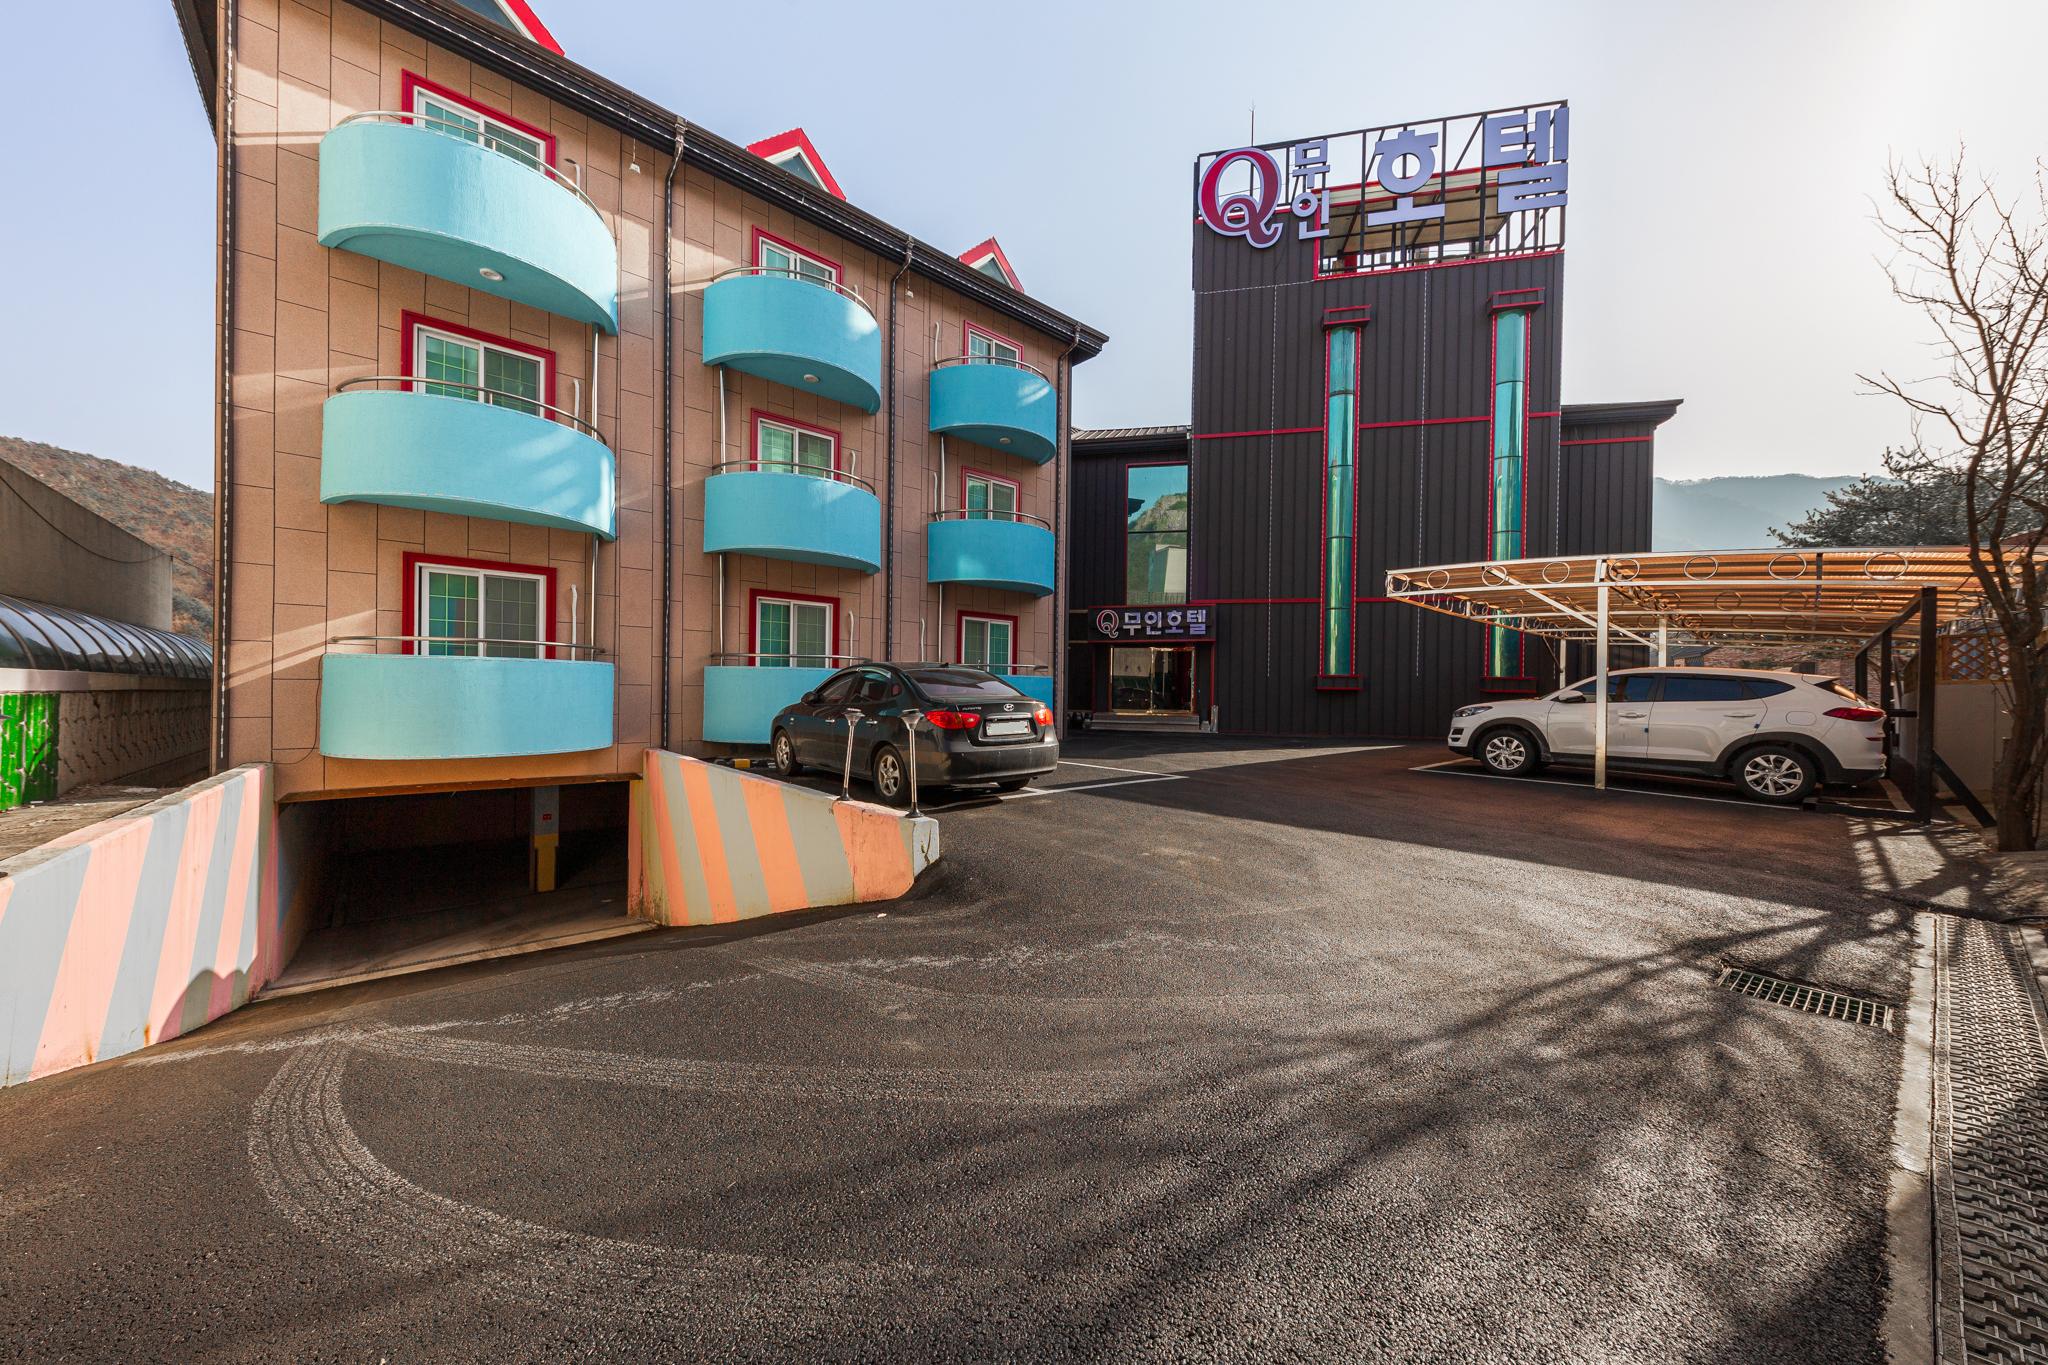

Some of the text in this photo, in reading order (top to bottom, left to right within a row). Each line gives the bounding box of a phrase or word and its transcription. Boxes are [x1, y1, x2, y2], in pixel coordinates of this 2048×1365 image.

[1199, 107, 1569, 249] Q 무인 호텔
[1096, 609, 1206, 639] Q 무인호텔
